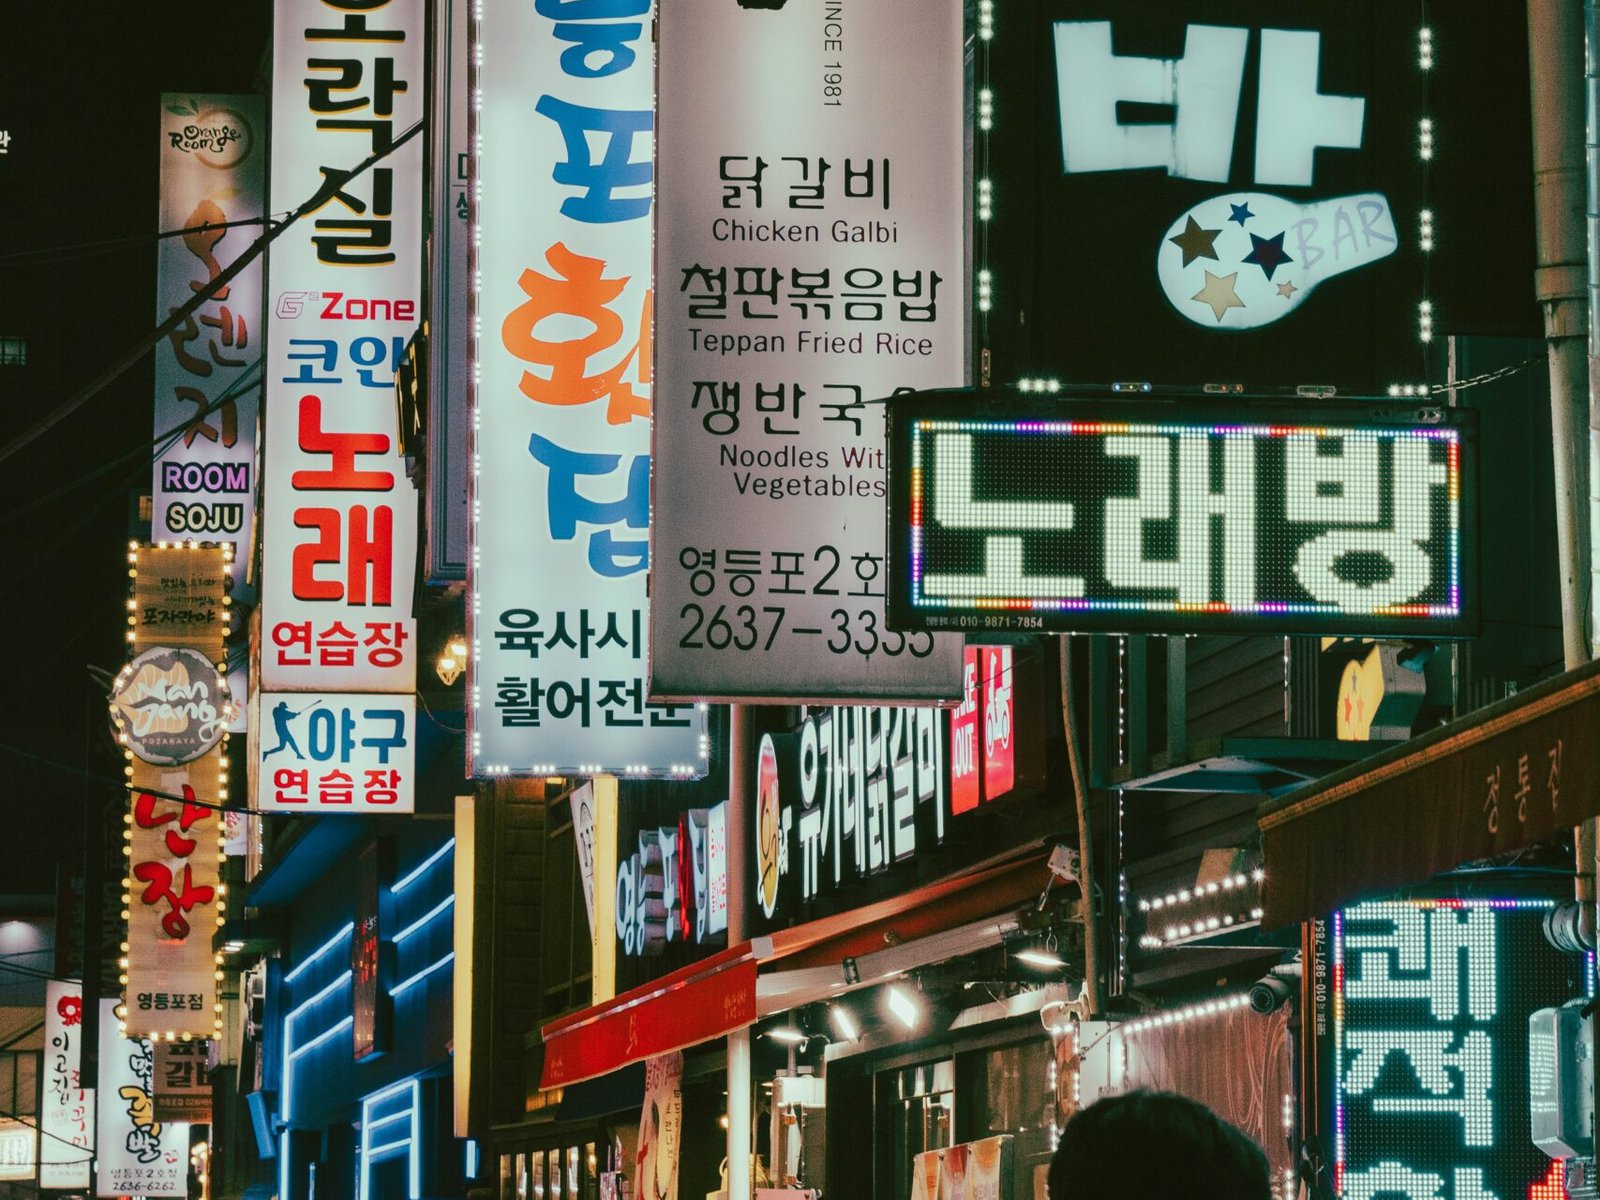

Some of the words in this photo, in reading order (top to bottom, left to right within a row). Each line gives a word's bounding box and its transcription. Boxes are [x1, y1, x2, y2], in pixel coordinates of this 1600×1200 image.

[823, 61, 842, 107] 1981
[168, 132, 224, 153] Room
[184, 125, 241, 147] Orange
[718, 155, 891, 210] 닭갈비
[711, 218, 820, 244] Chicken
[831, 220, 898, 244] Galbi
[1293, 200, 1395, 269] BAR
[680, 263, 943, 323] 철판볶음밥
[282, 335, 404, 389] 코인
[688, 329, 786, 357] Teppan
[797, 331, 863, 355] Fried
[876, 332, 933, 357] Rice
[691, 380, 886, 437] 쟁반국
[163, 464, 248, 491] ROOM
[720, 443, 829, 470] Noodles
[841, 446, 886, 470] Wit
[291, 394, 395, 607] 노래
[734, 473, 886, 500] Vegetables
[167, 503, 242, 533] SOJU
[923, 432, 1448, 613] 노래방
[680, 544, 886, 598] 영등포2호
[271, 621, 409, 668] 연습장
[494, 607, 642, 659] 육사시
[960, 615, 1043, 628] 010-9871-7854
[142, 737, 196, 746] POZAKAYA
[308, 707, 407, 764] 야구
[954, 722, 975, 779] OUT
[273, 768, 403, 805] 연습장
[133, 784, 215, 941] 난장
[1316, 919, 1326, 1002] 010-9871-7854
[136, 991, 204, 1011] 영등포점
[112, 1181, 176, 1192] 2636-6262
